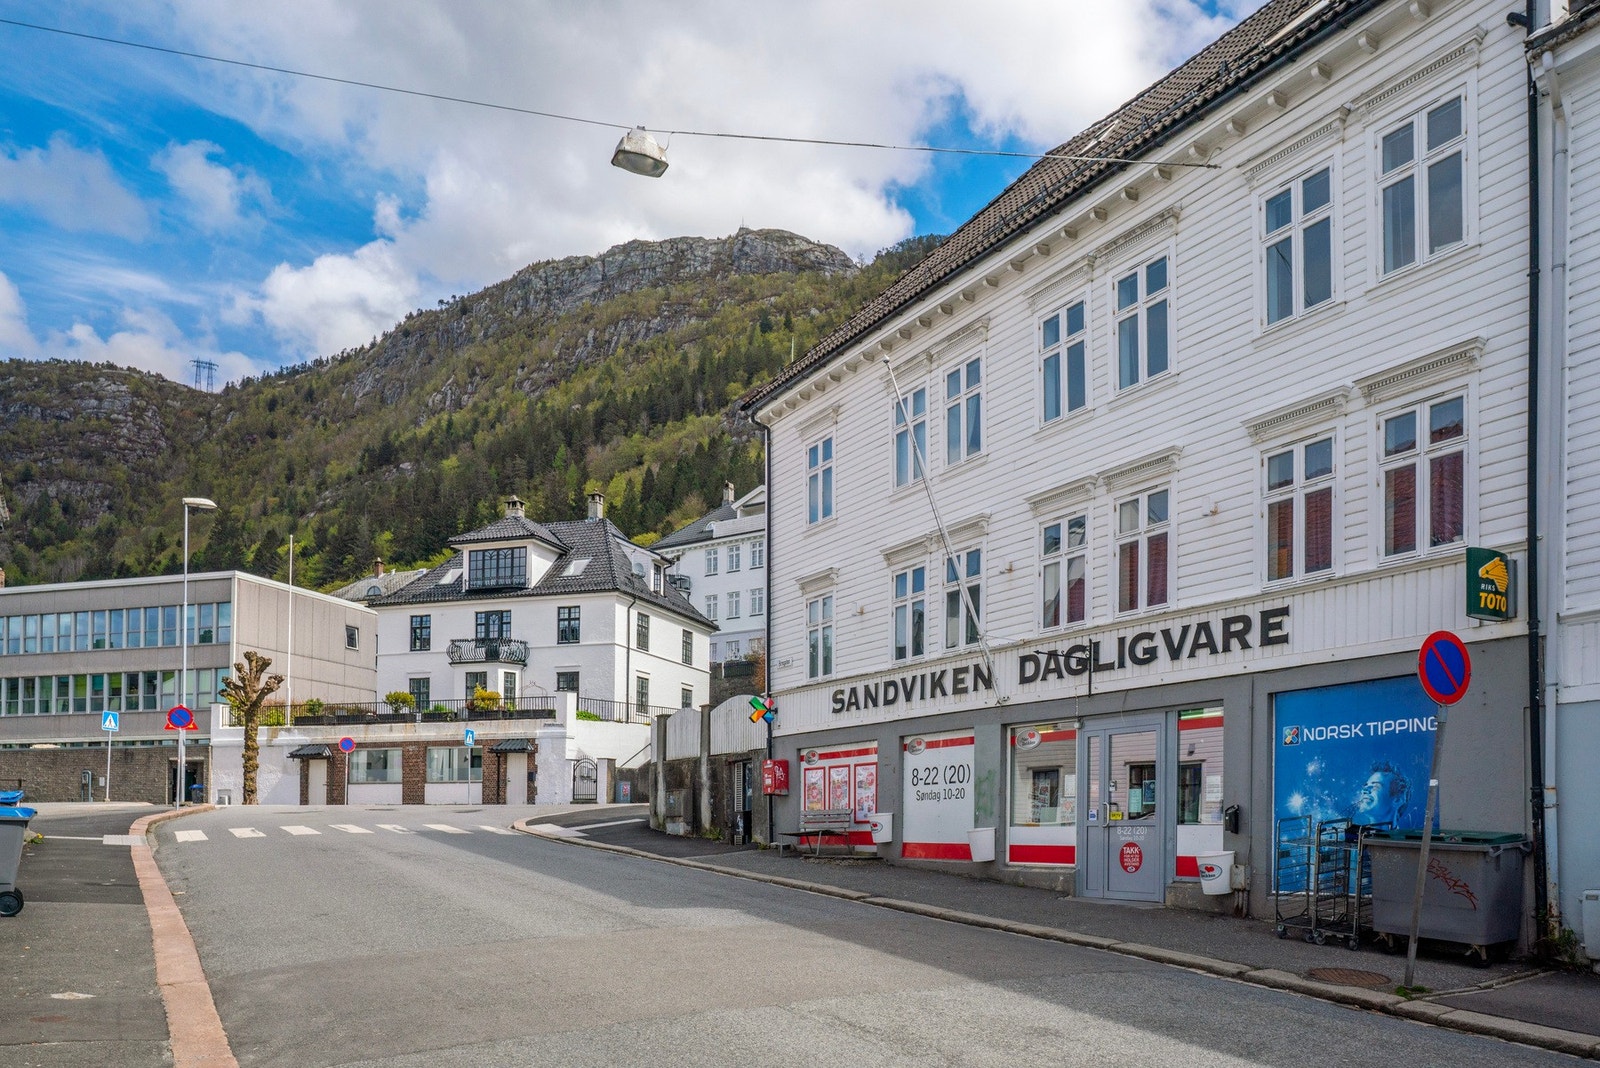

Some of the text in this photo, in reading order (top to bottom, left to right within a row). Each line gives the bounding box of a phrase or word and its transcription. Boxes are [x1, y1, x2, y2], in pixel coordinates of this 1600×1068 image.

[1480, 583, 1496, 592] RIKS
[1479, 592, 1507, 613] TOTO
[832, 604, 1290, 713] SANDVIKEN DAGLIGVARE
[1303, 716, 1438, 742] NORSK TIPPING
[911, 763, 971, 786] 8-22 (20)
[916, 787, 966, 802] Søndag 10-20
[1117, 826, 1147, 835] 8-22 (20)
